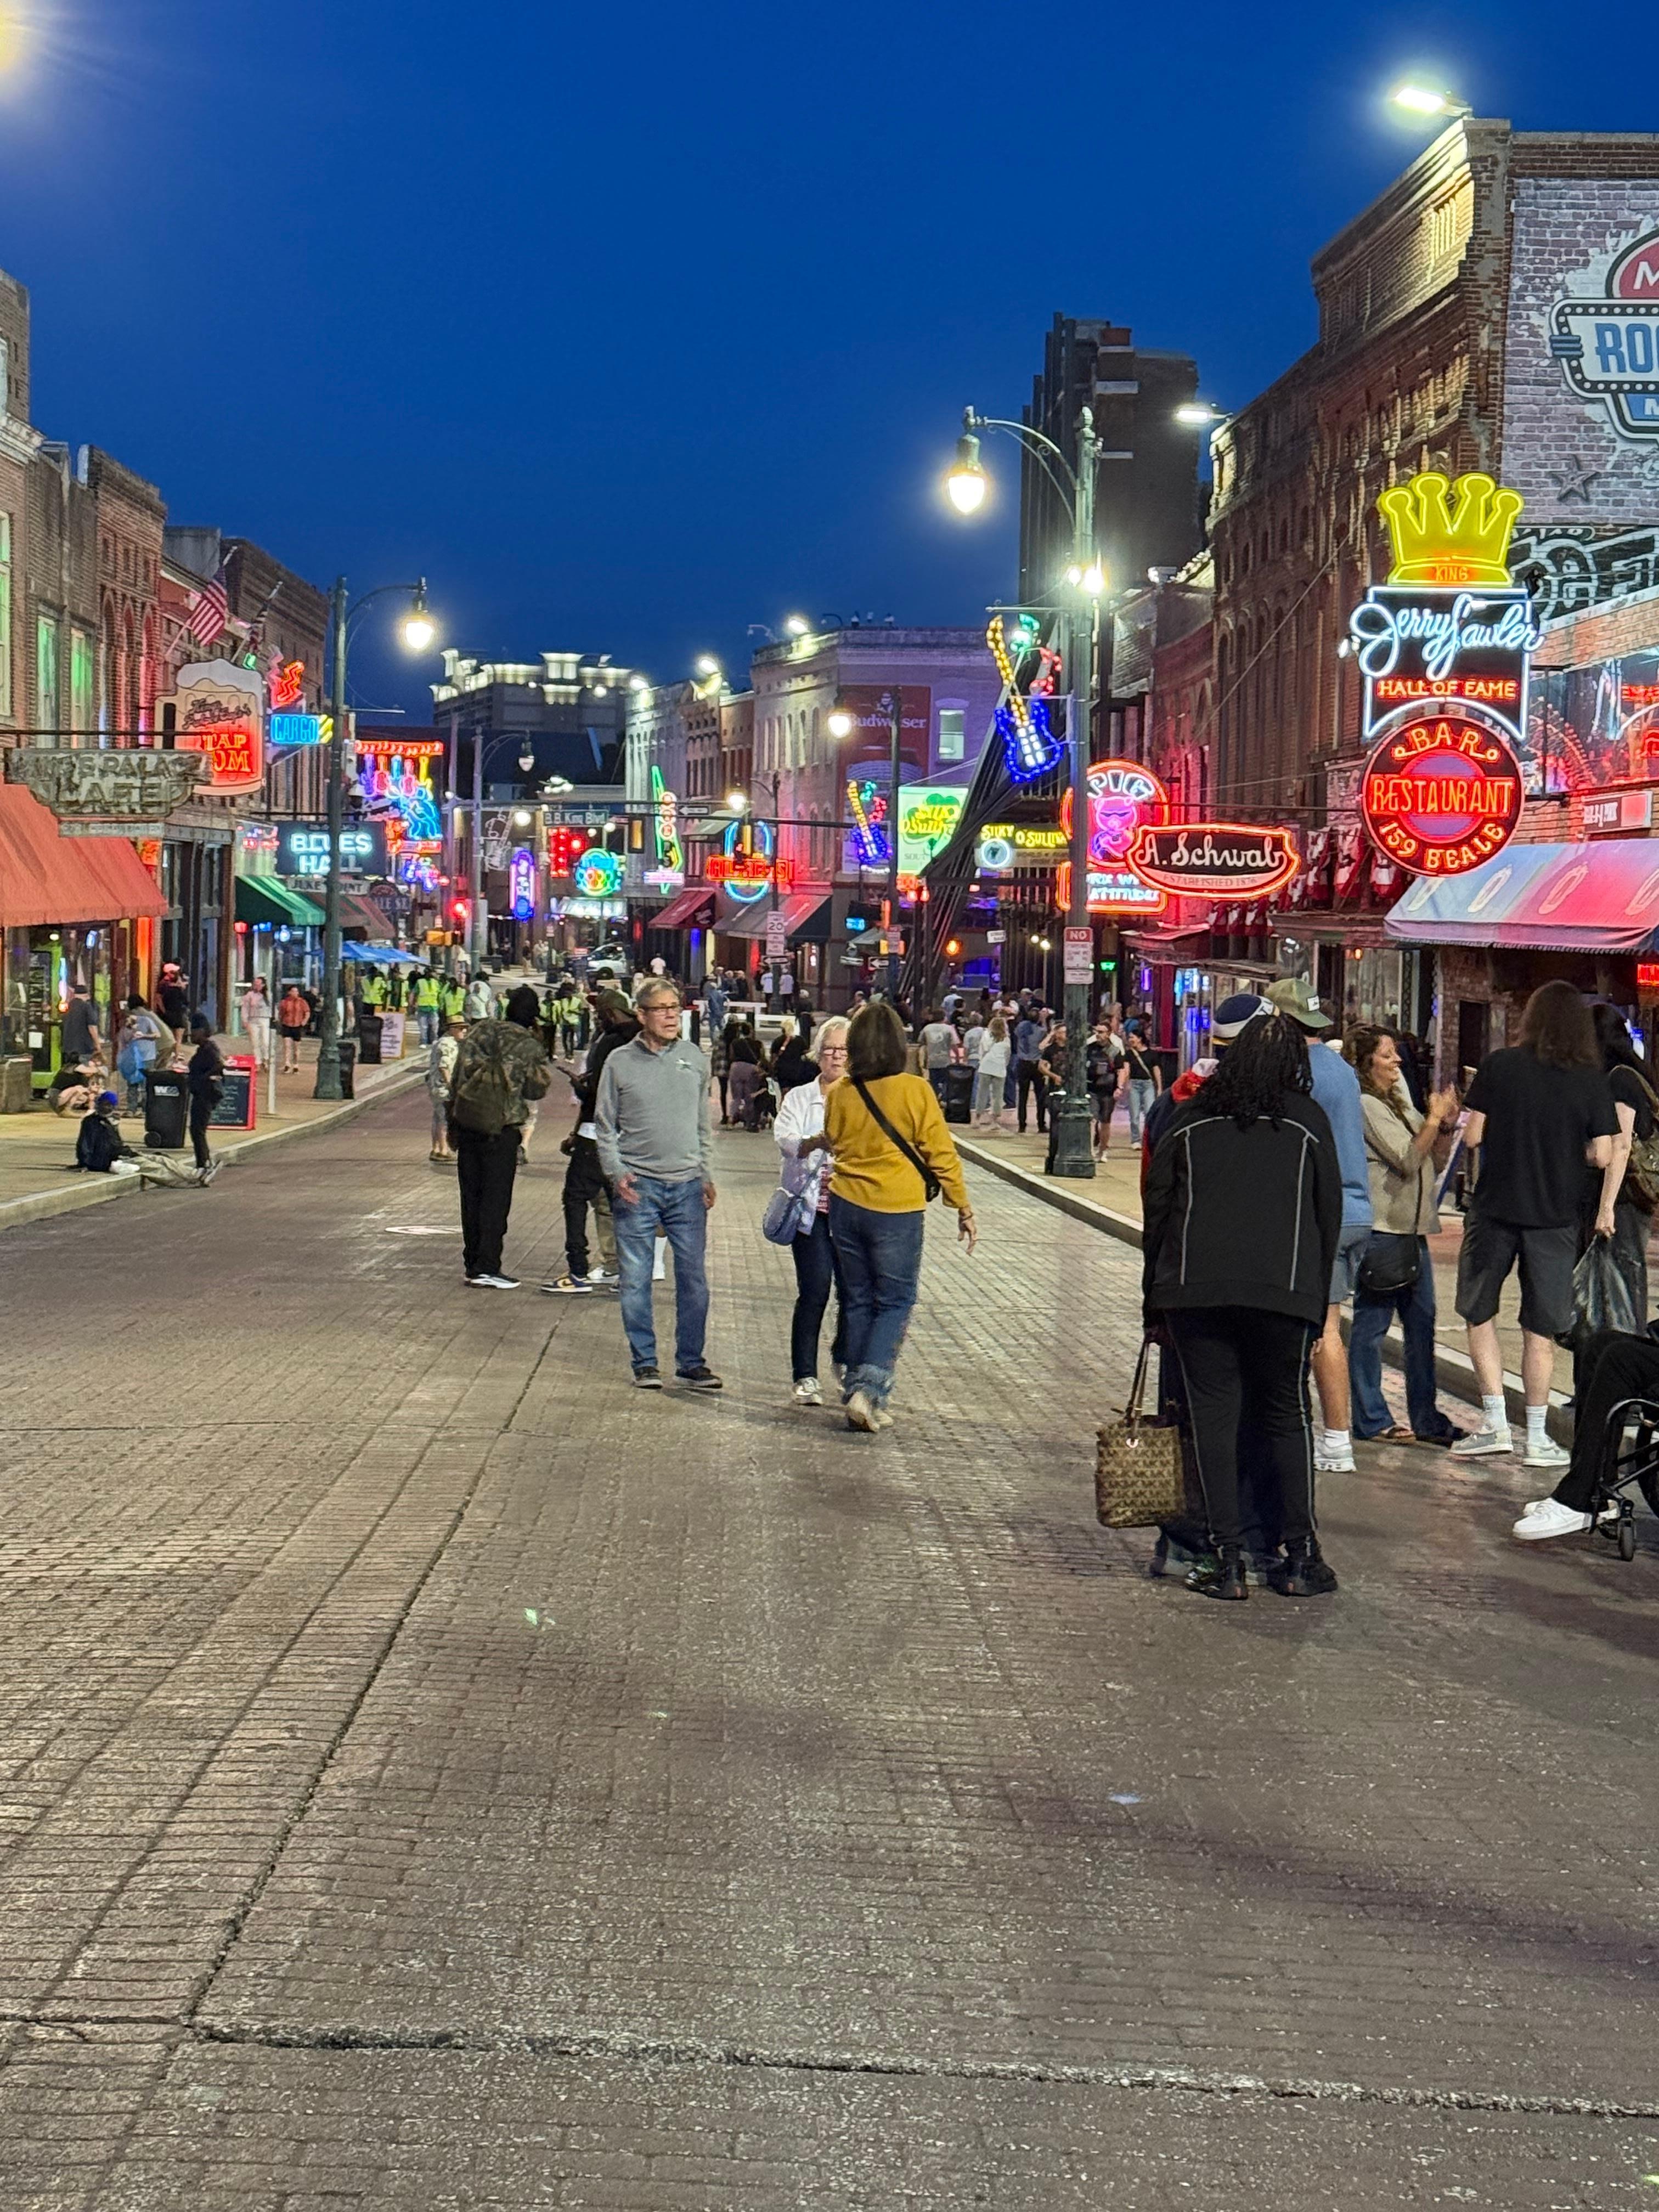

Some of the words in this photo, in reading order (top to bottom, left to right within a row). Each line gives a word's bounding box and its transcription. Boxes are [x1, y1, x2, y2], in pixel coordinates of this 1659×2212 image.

[1595, 323, 1659, 373] RO
[1435, 566, 1468, 581] KING
[1350, 603, 1457, 678] Jerry
[1426, 593, 1545, 681] Lawler
[1379, 680, 1429, 696] HALL
[1431, 680, 1458, 696] OF
[1464, 680, 1517, 697] FAME
[274, 716, 317, 741] CARGO
[850, 714, 927, 729] udwser
[202, 733, 247, 751] TAP
[1403, 723, 1488, 755] BAR
[213, 750, 251, 772] OM
[1372, 778, 1514, 814] RESTAURANT
[564, 812, 584, 825] King
[980, 825, 1015, 840] SILKY
[1135, 833, 1167, 866] A.
[1171, 832, 1288, 867] Schwab
[1380, 822, 1417, 857] 159
[1426, 823, 1504, 869] BEALE
[1164, 873, 1233, 887] ESTABLISHED
[769, 922, 783, 931] 20
[1069, 930, 1087, 940] NO
